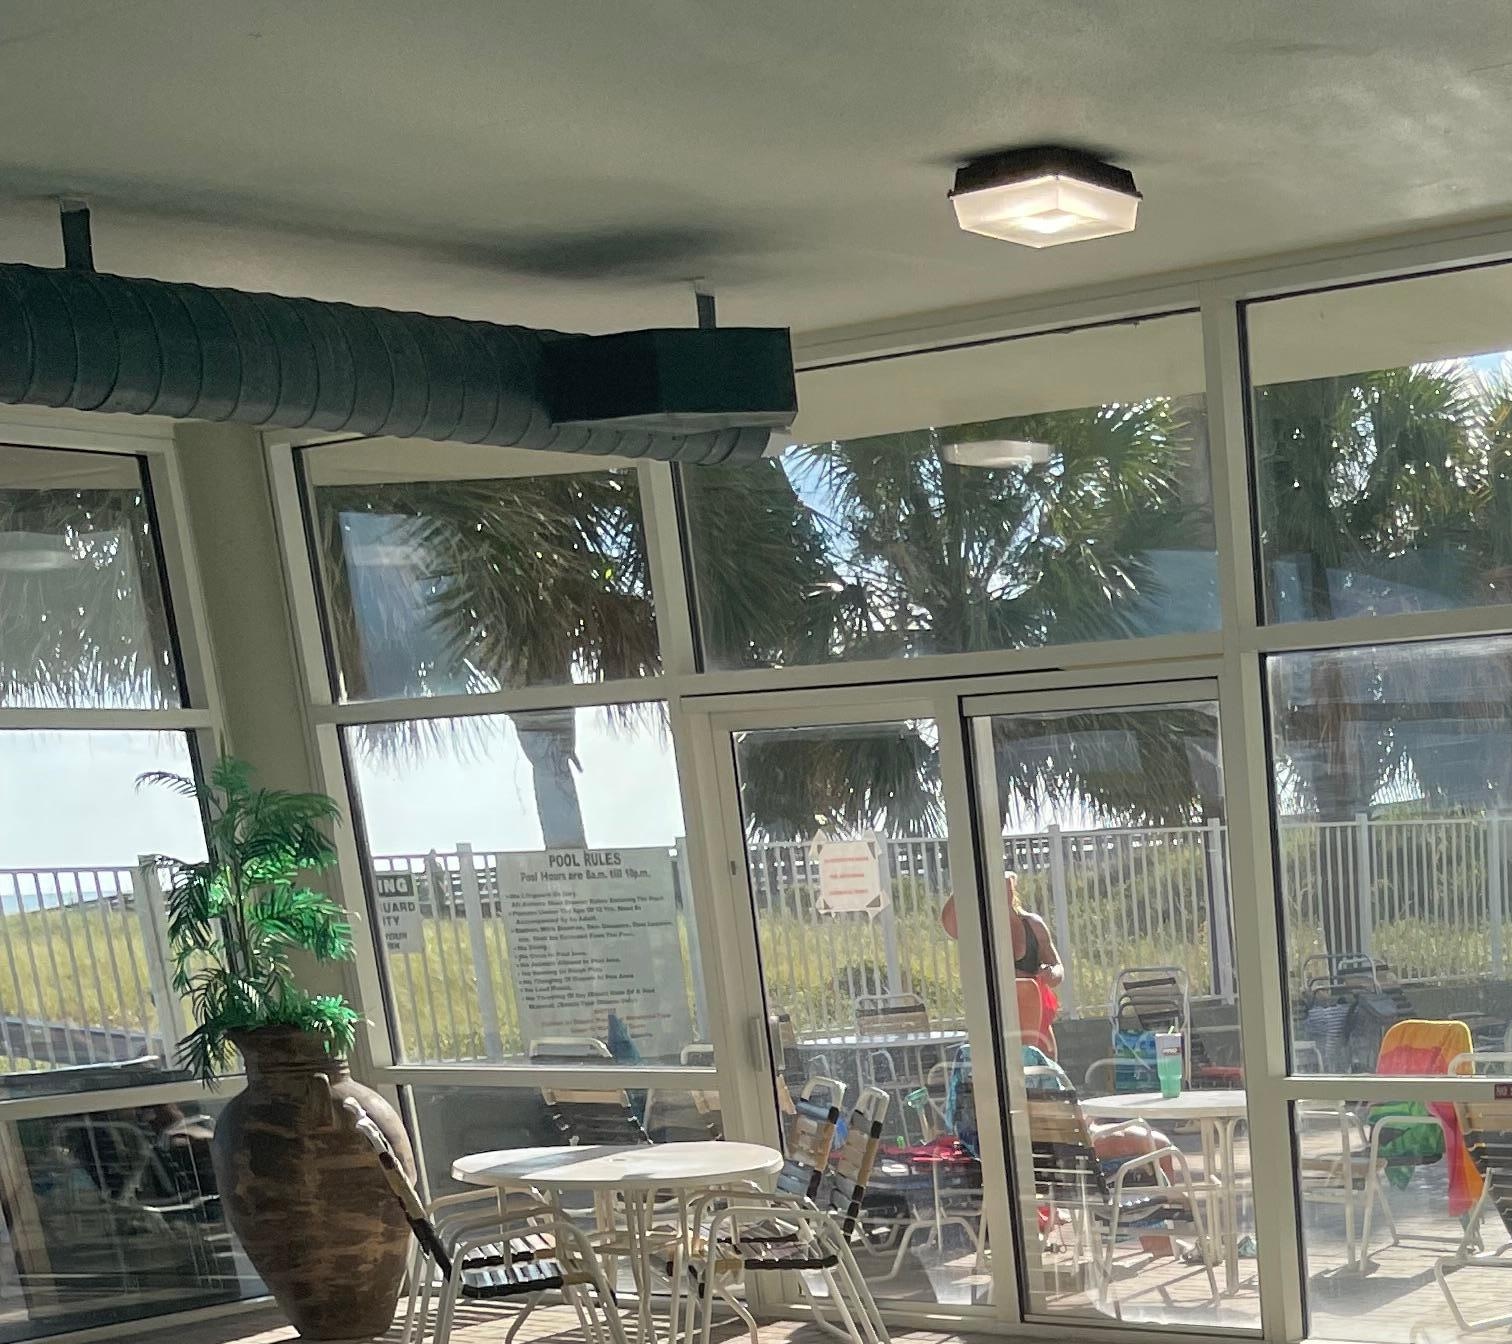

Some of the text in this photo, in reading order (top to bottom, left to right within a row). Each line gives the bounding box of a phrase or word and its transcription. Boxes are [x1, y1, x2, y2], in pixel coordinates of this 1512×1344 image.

[550, 852, 621, 868] POOL RULES
[520, 872, 537, 882] Pool
[540, 870, 567, 882] Hours
[568, 871, 583, 880] are
[609, 868, 622, 879] till
